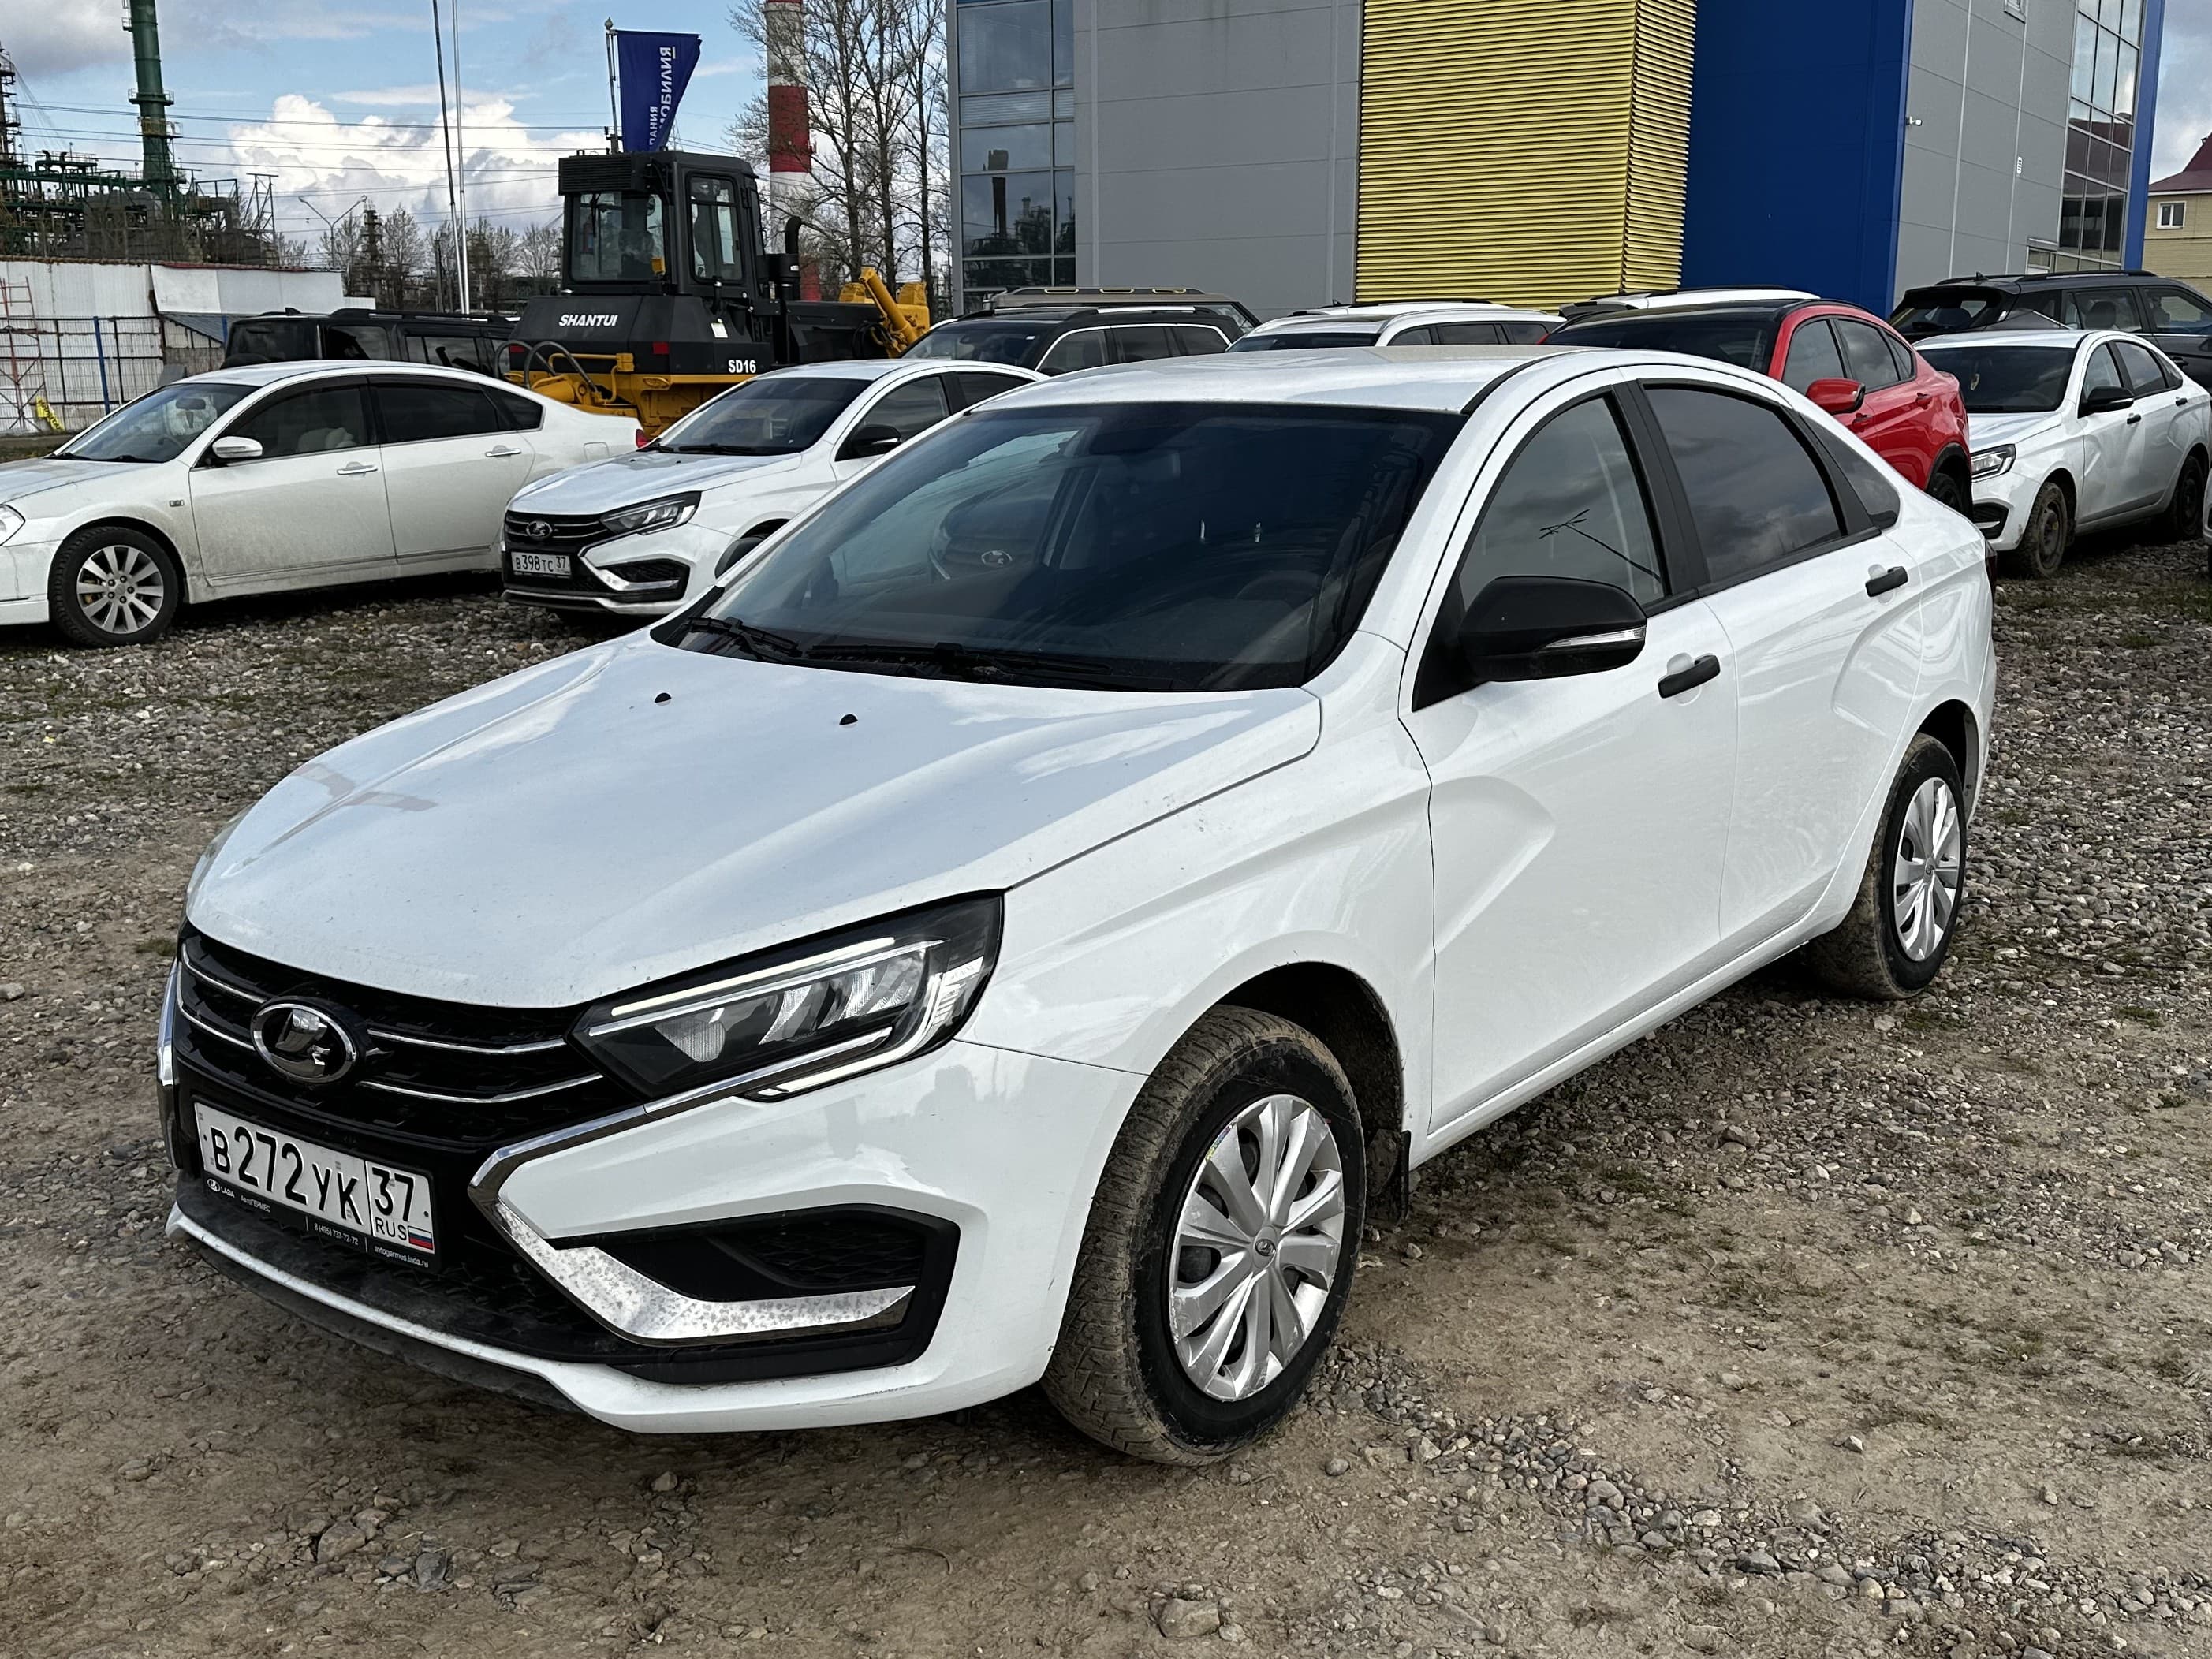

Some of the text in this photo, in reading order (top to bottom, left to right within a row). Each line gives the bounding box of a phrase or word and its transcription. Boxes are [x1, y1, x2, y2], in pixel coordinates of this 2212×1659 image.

[558, 315, 618, 326] SHANTUI
[728, 359, 756, 374] SD16
[556, 556, 566, 569] 37
[371, 1167, 415, 1222] 37
[375, 1217, 407, 1241] RUS
